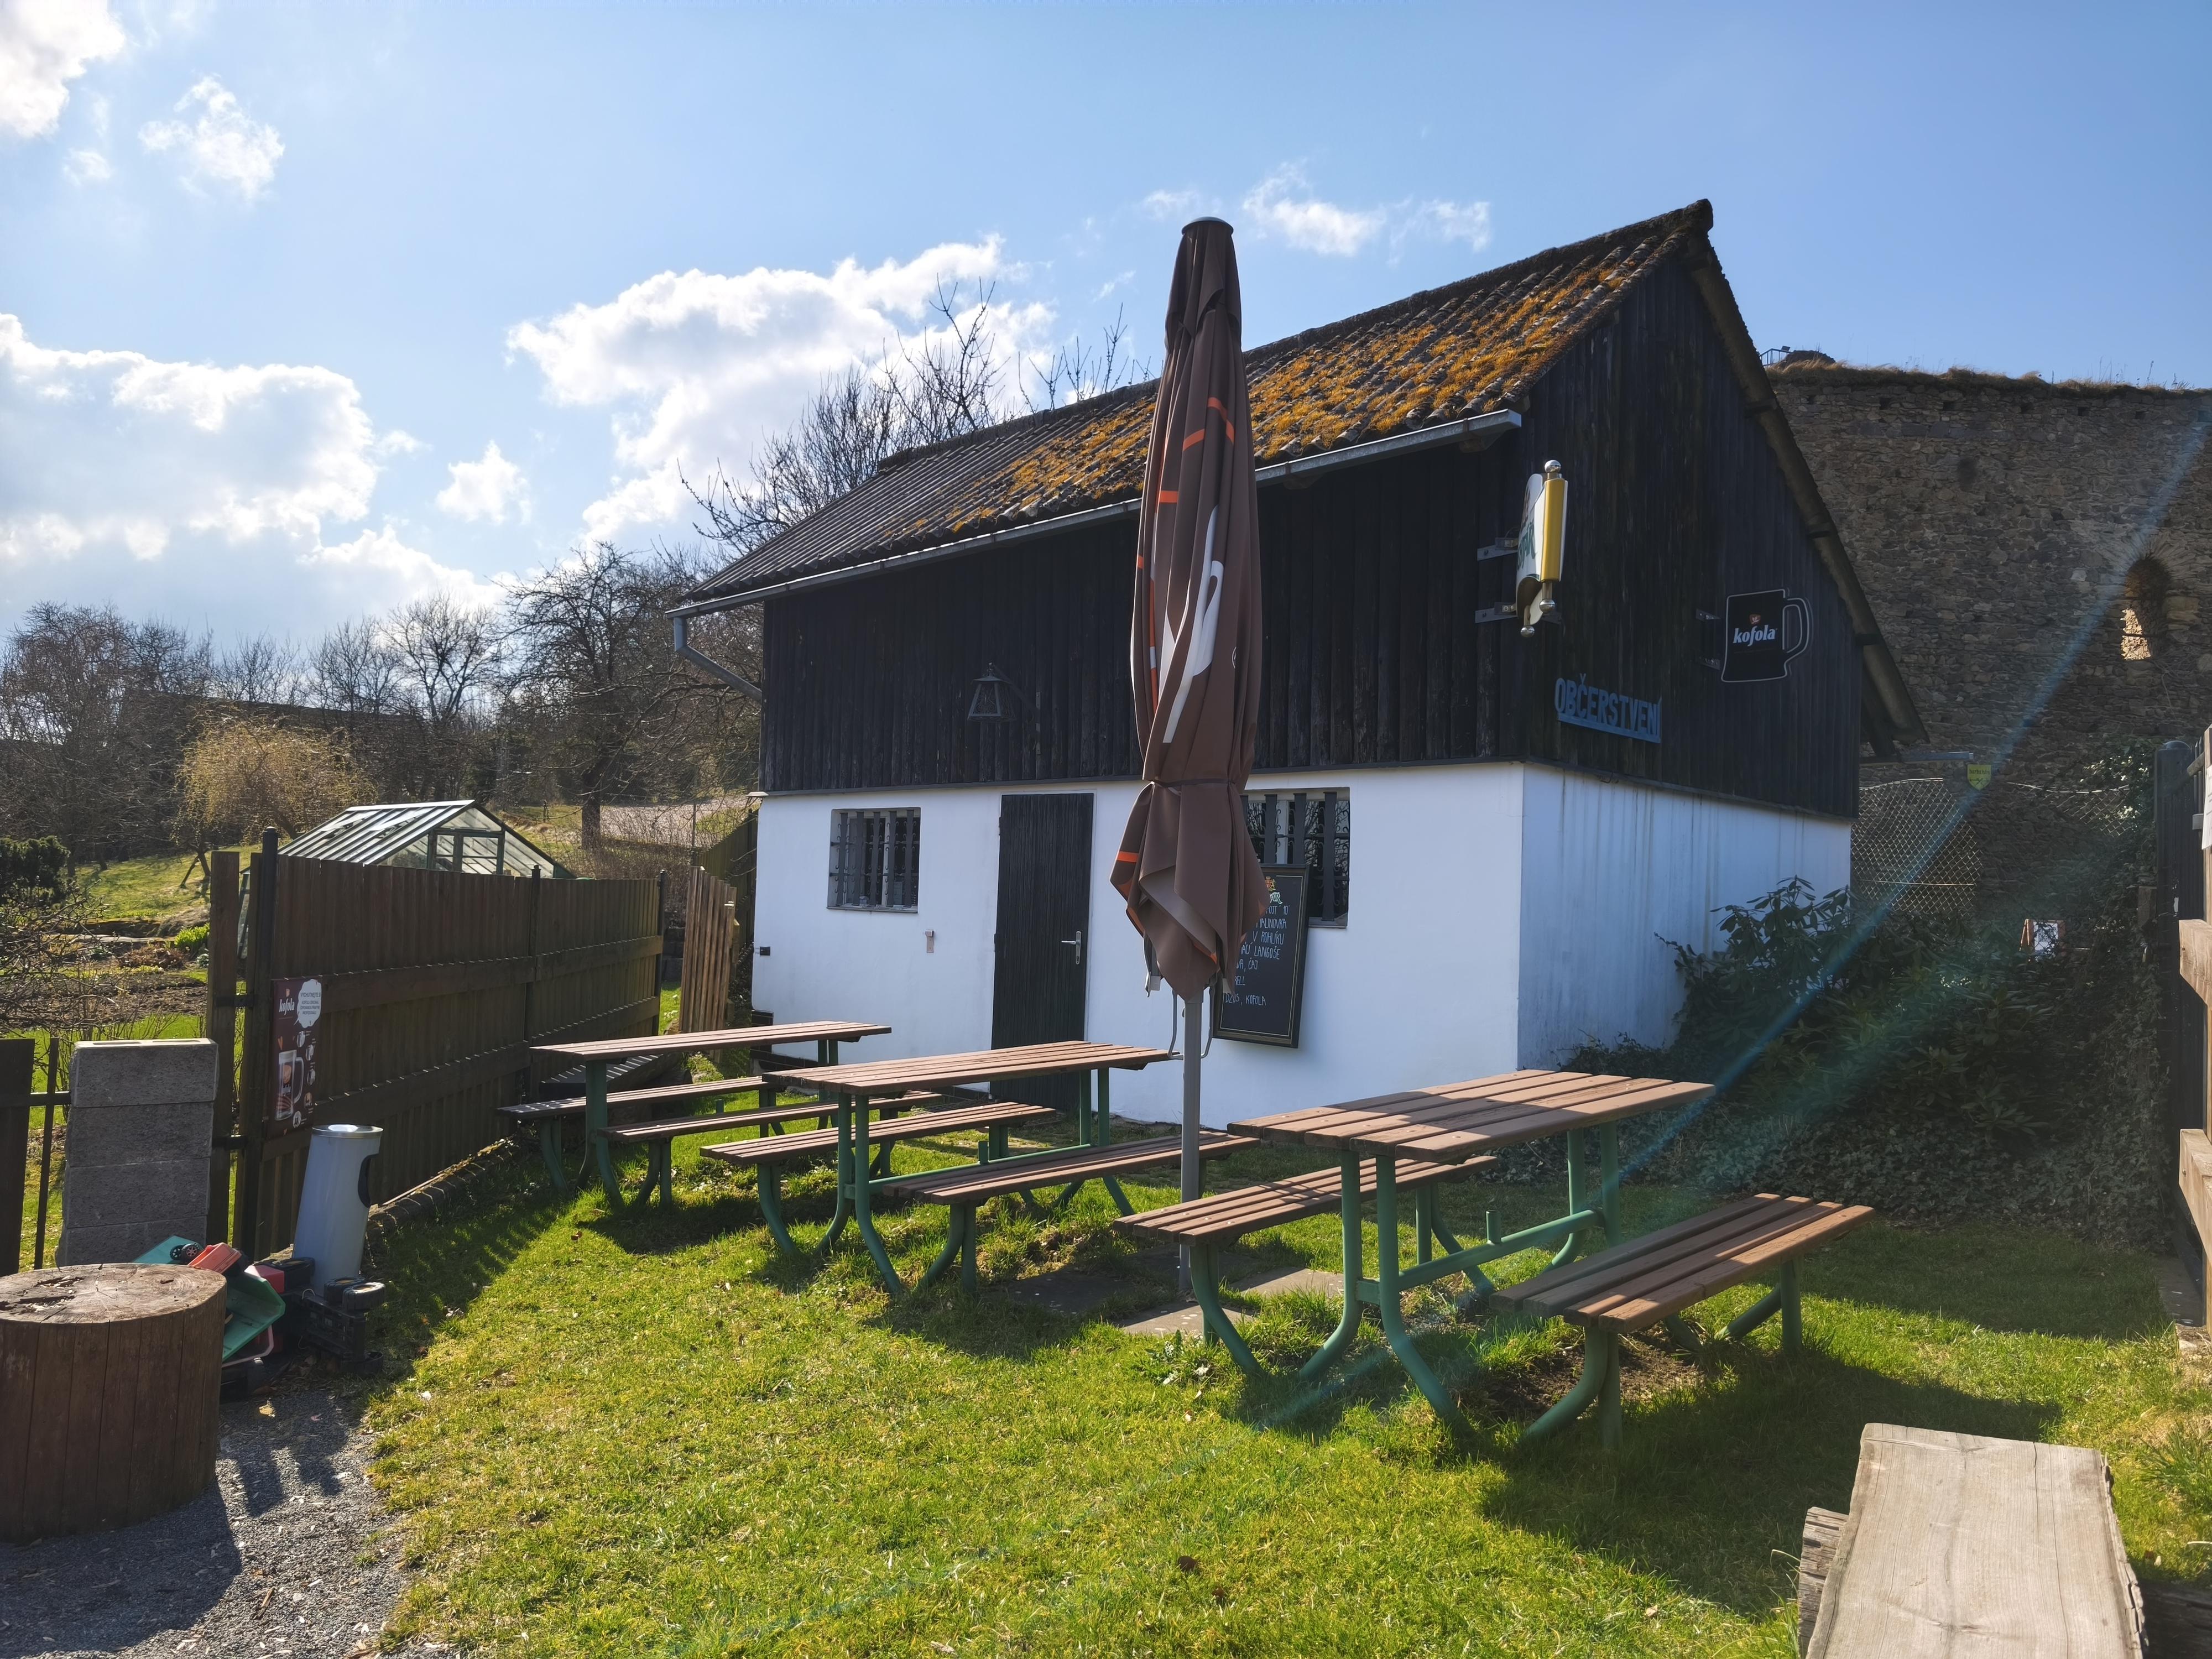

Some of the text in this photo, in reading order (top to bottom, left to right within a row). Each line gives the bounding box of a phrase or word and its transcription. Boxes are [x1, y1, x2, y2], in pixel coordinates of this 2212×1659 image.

[1733, 624, 1776, 647] kofola
[1554, 672, 1662, 738] OBČERSTVENÍ
[1260, 930, 1284, 945] ROHLÍKU
[1254, 946, 1281, 959] LANGOŠE
[1248, 957, 1258, 970] ČAJ
[279, 997, 295, 1015] kofola
[1245, 995, 1266, 1006] KOFOLA
